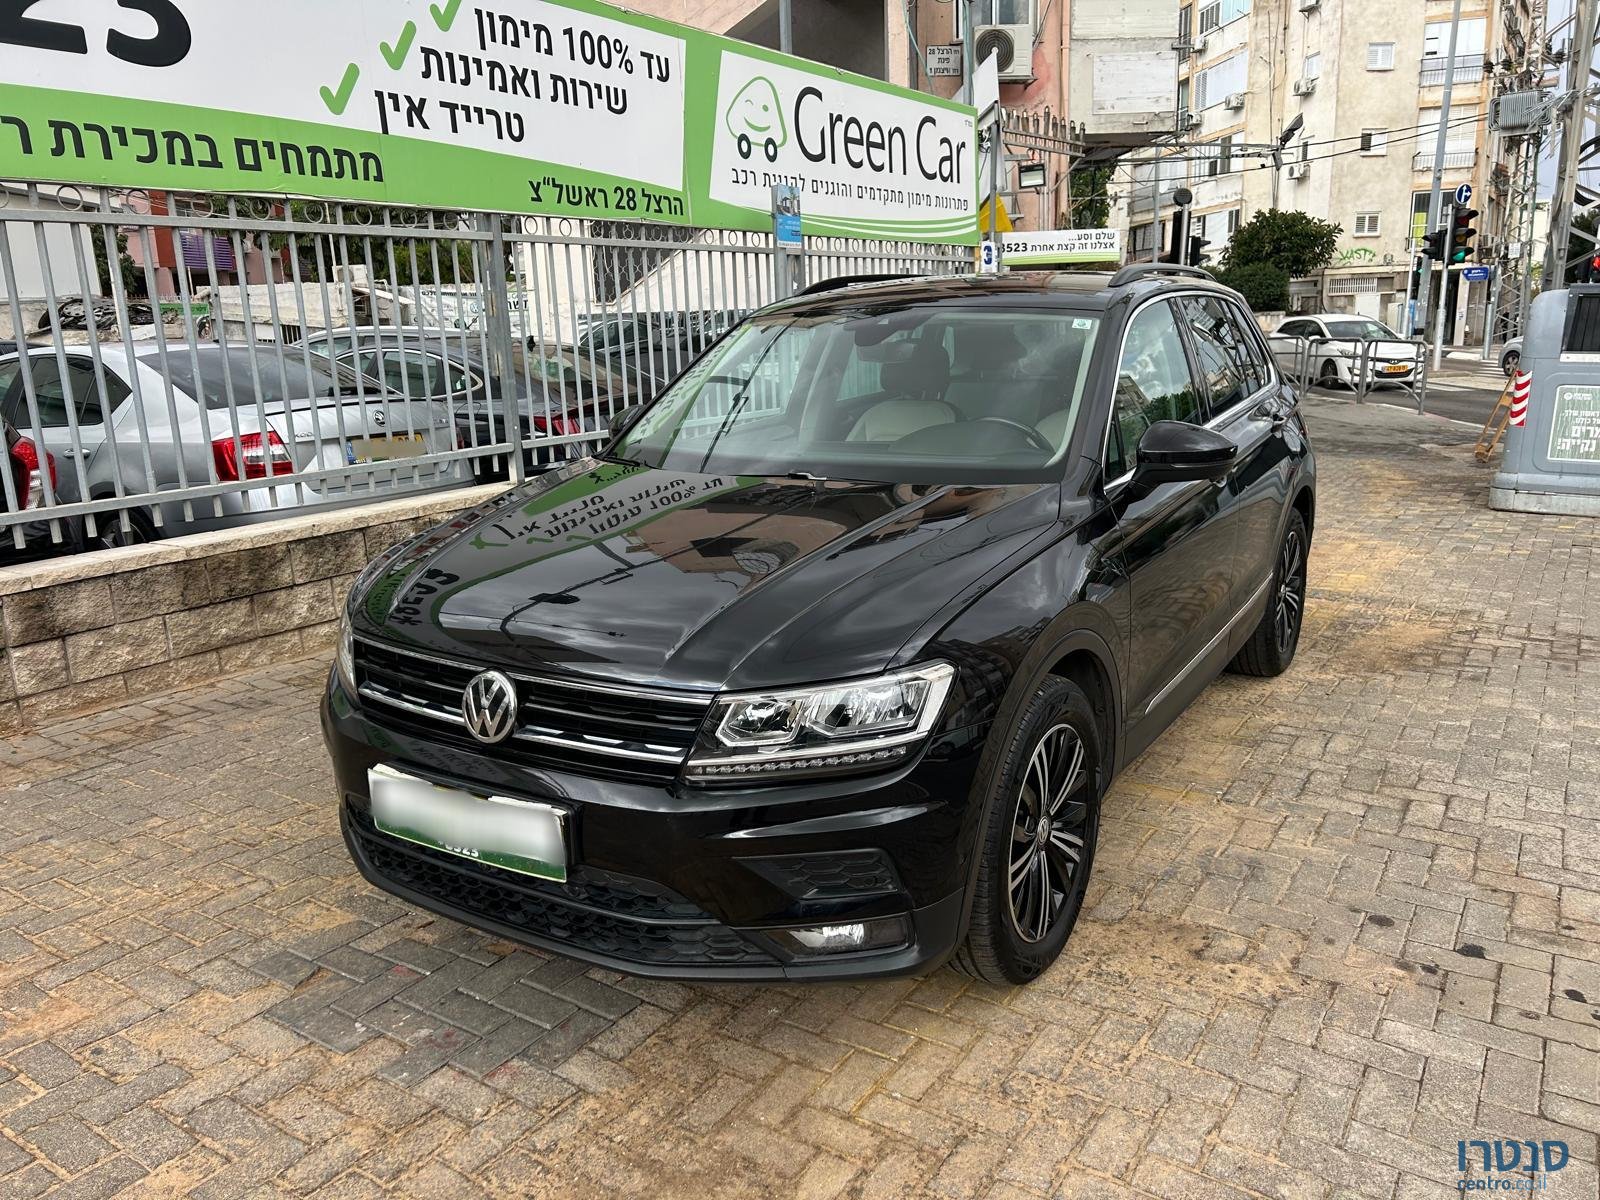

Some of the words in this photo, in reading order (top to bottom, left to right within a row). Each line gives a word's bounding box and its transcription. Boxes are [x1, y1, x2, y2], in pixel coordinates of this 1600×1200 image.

[474, 8, 553, 56] מימון
[562, 26, 633, 75] 100%
[420, 46, 541, 99] ואמינות
[640, 50, 670, 82] עד
[550, 73, 627, 115] שירות
[374, 90, 430, 135] אין
[439, 100, 524, 143] טרייד
[48, 119, 223, 168] במכירת
[794, 86, 907, 176] Green
[916, 115, 966, 184] Car
[234, 137, 384, 182] מתמחים
[732, 168, 756, 186] רכב
[812, 179, 852, 198] והוגנים
[613, 185, 637, 211] 28
[641, 188, 684, 216] הרצל
[857, 185, 904, 206] מתקדמים
[908, 192, 931, 208] מימון
[935, 196, 968, 211] פתרונות
[1030, 243, 1055, 252] אחרת
[1057, 243, 1075, 252] קצת
[1090, 241, 1115, 250] אצלנו
[1095, 231, 1115, 240] שלם
